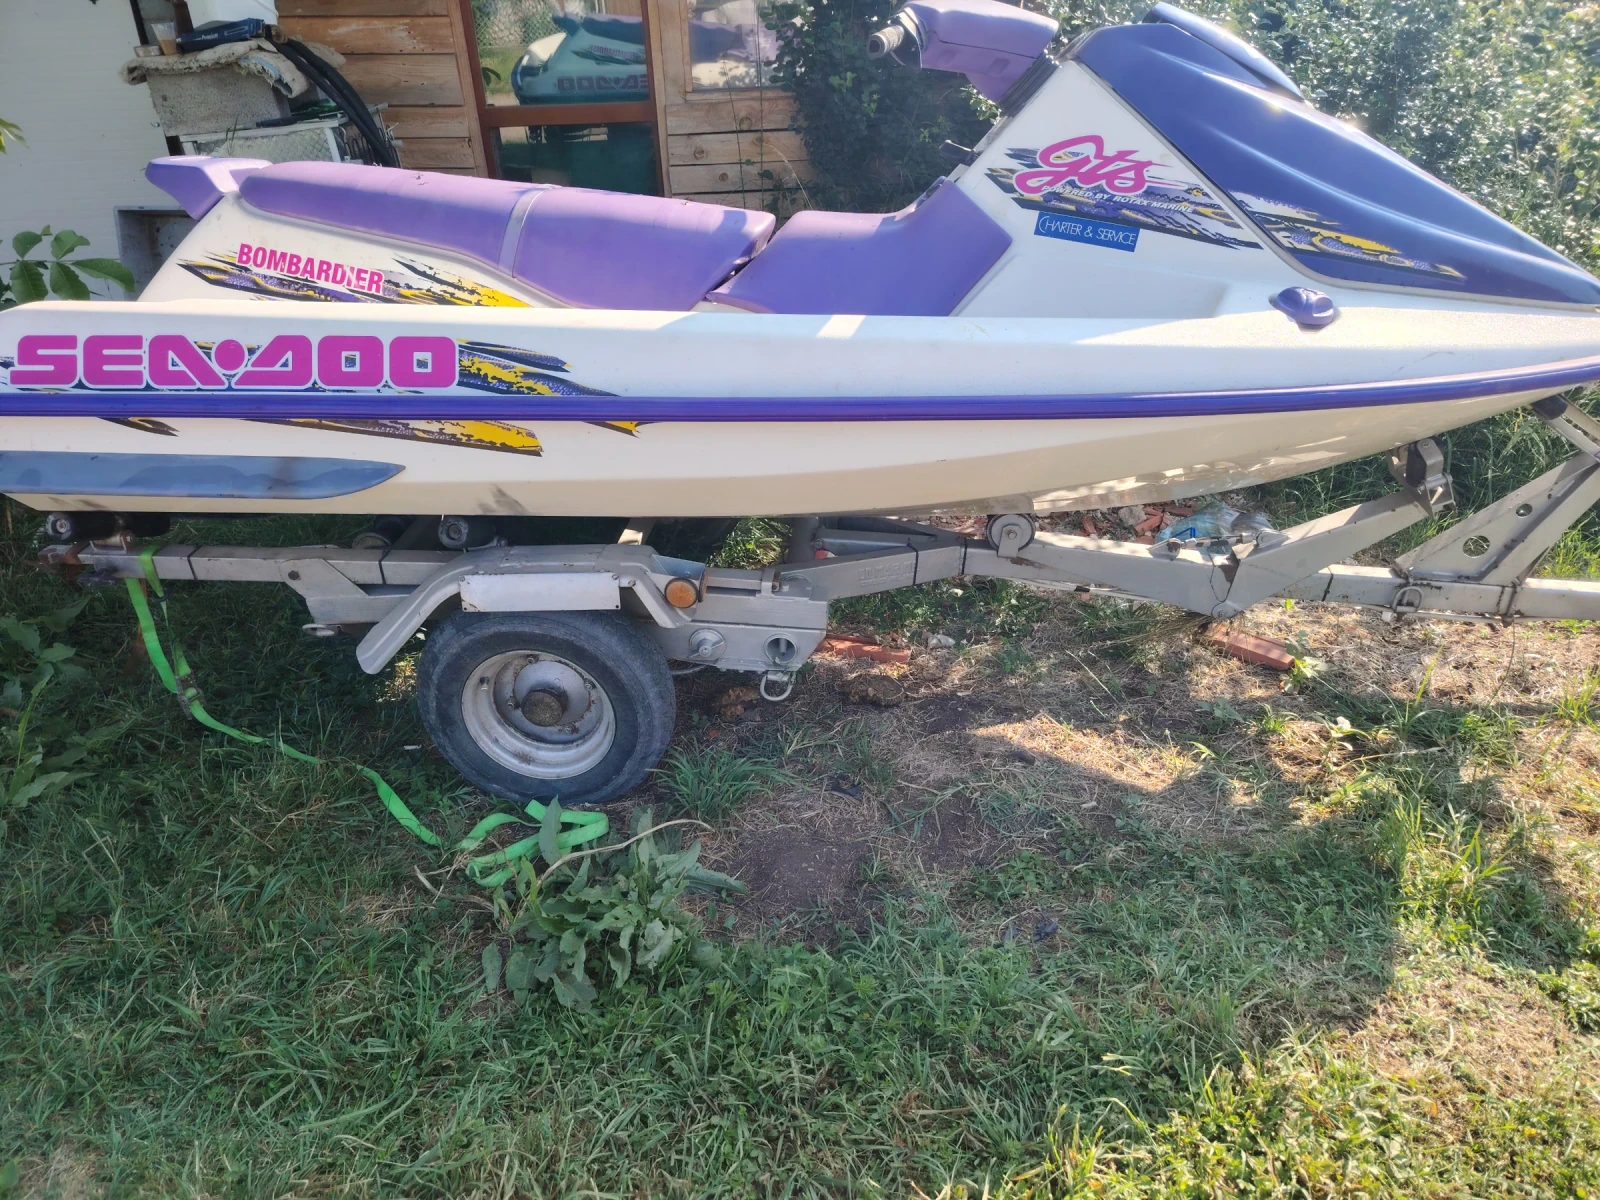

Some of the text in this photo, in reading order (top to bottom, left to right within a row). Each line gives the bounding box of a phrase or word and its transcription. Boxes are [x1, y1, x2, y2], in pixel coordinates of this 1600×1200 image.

[1041, 185, 1195, 214] POWERED BY ROTAX MARINE
[1038, 215, 1136, 245] CHARTER & SERVICE
[237, 243, 385, 294] BOMBARDIER
